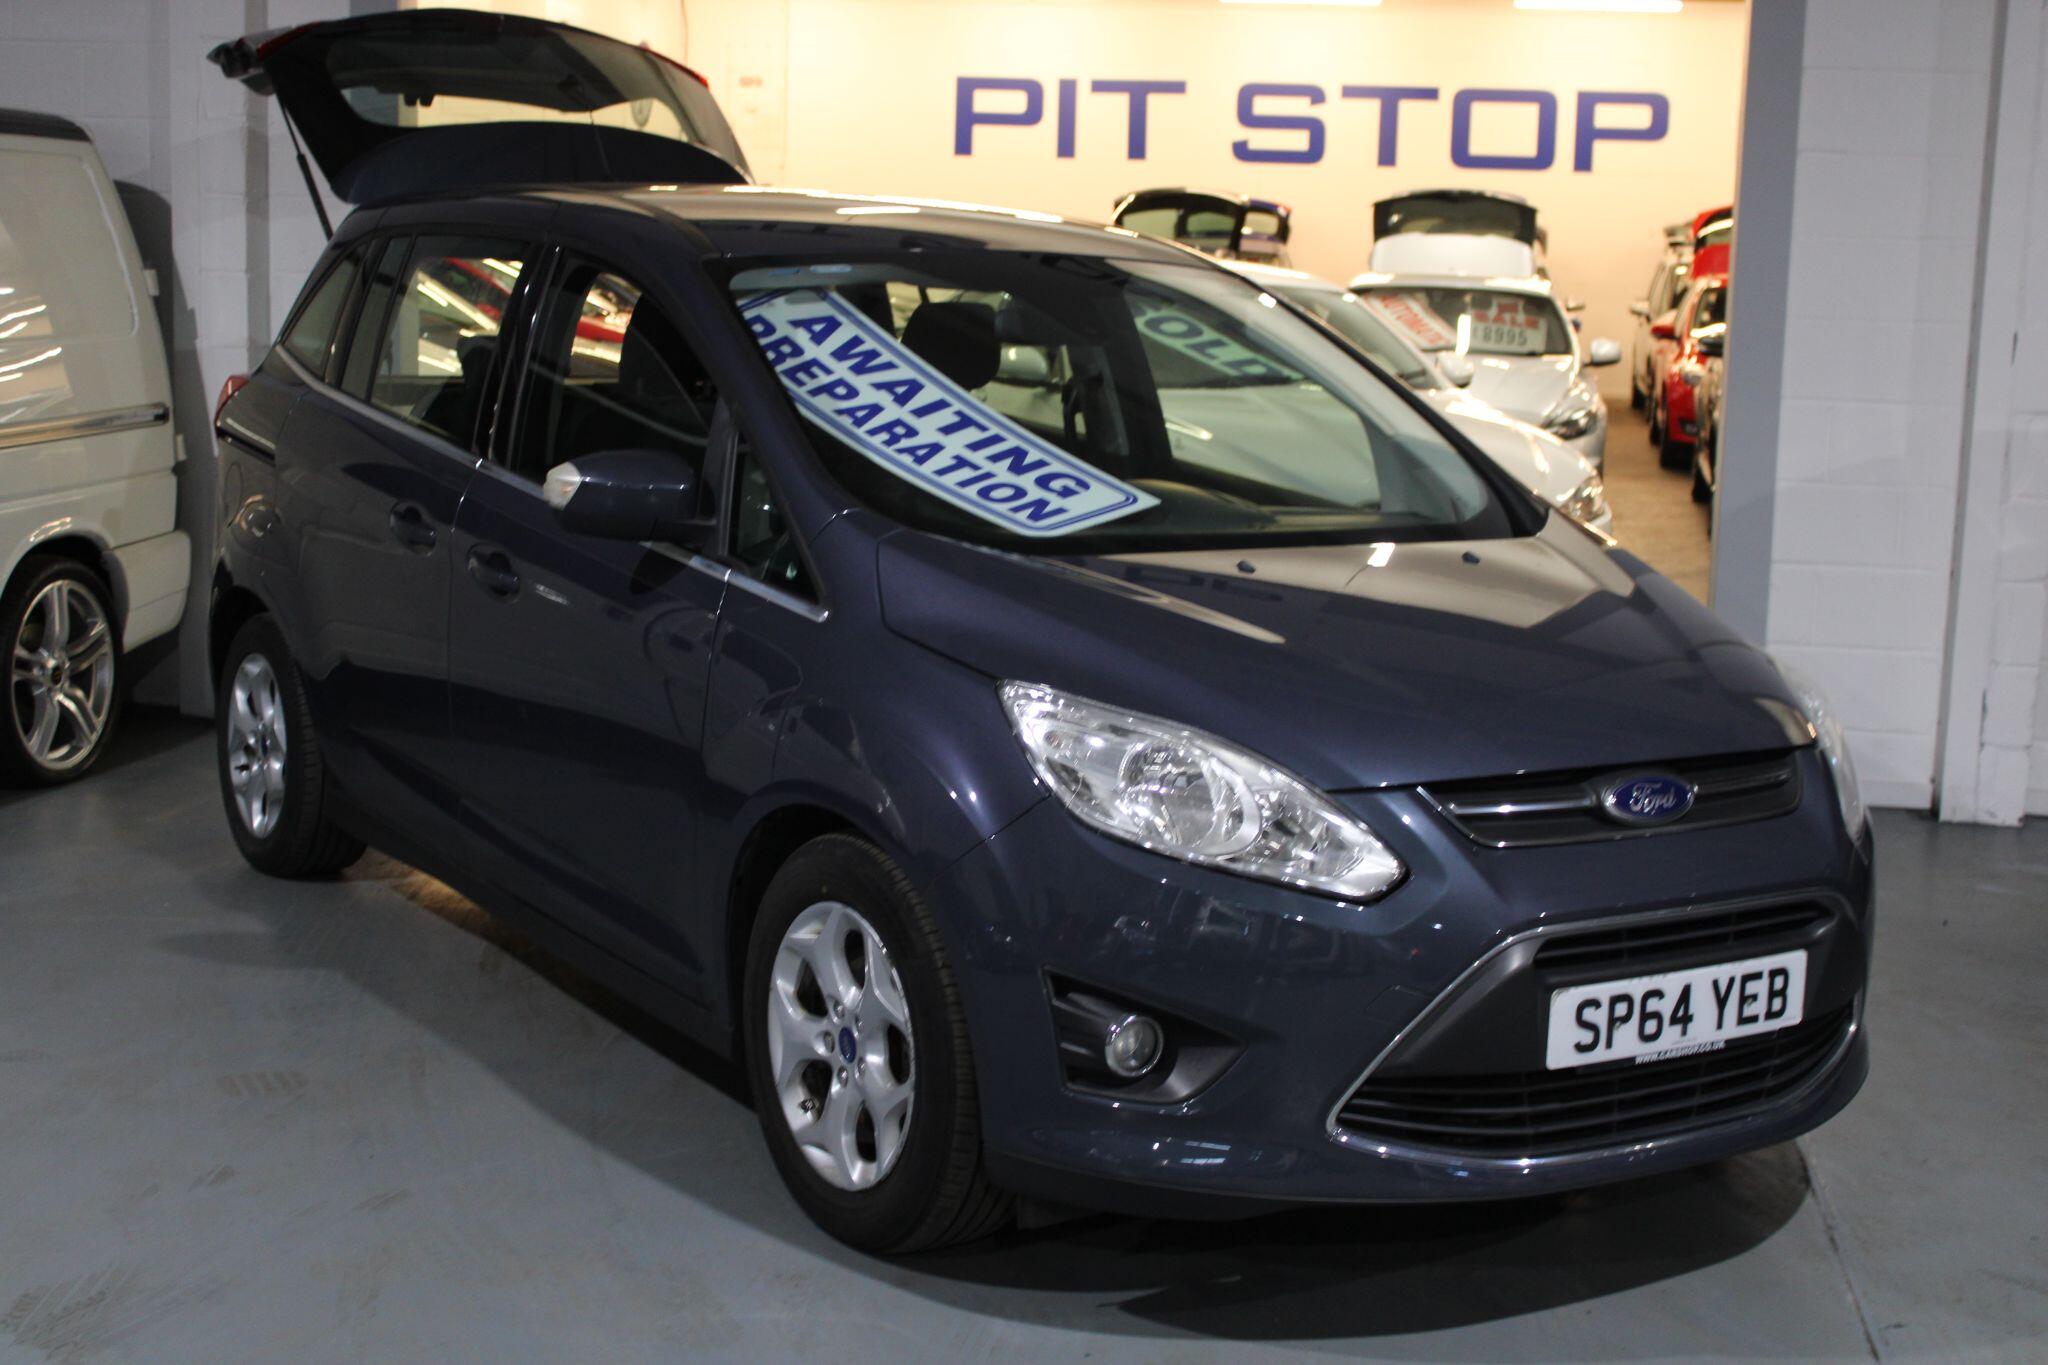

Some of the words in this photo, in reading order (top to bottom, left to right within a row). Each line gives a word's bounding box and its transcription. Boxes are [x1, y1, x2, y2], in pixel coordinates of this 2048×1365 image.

[954, 76, 1187, 160] PIT
[1232, 82, 1671, 173] STOP
[788, 313, 1091, 500] AWAITING
[1629, 782, 1679, 816] Ford
[1574, 982, 1694, 1054] SP64
[1712, 967, 1790, 1031] YEB
